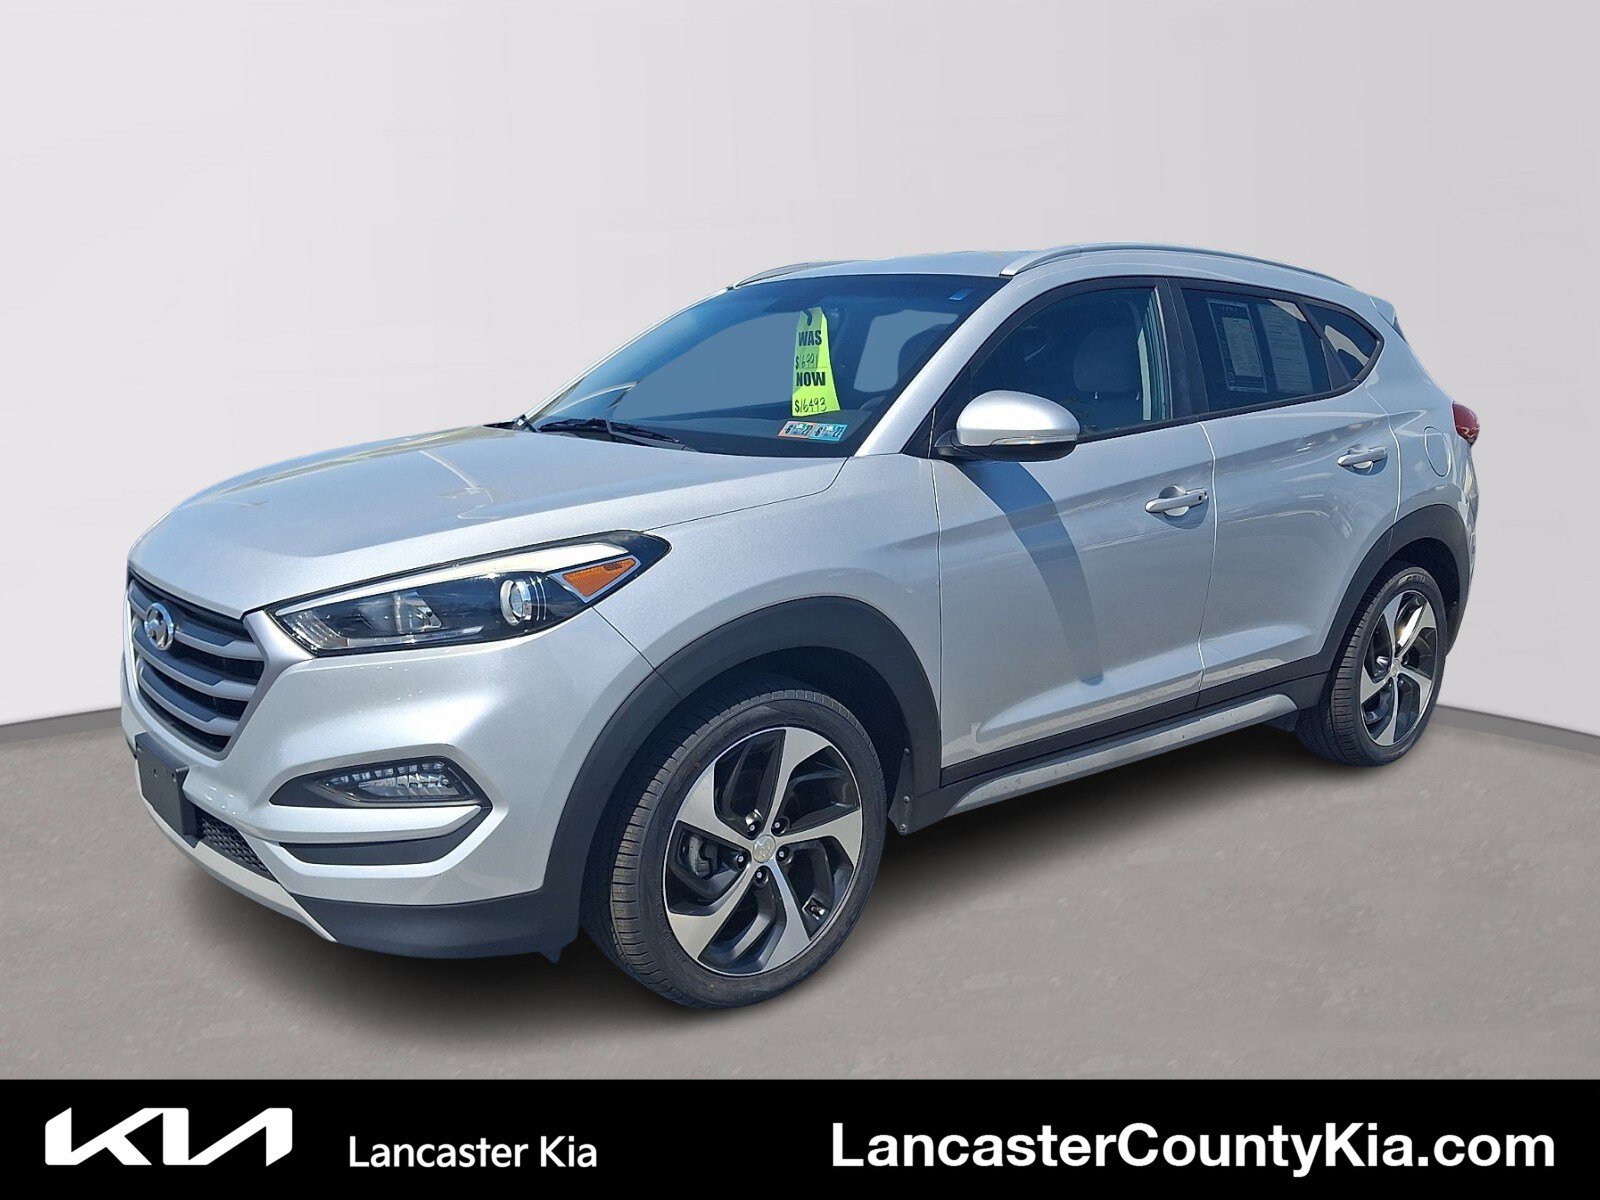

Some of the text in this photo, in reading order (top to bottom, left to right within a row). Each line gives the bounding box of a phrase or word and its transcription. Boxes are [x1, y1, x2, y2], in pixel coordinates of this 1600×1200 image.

[798, 331, 822, 346] WAS
[796, 372, 826, 387] NOW
[794, 397, 827, 414] $16493
